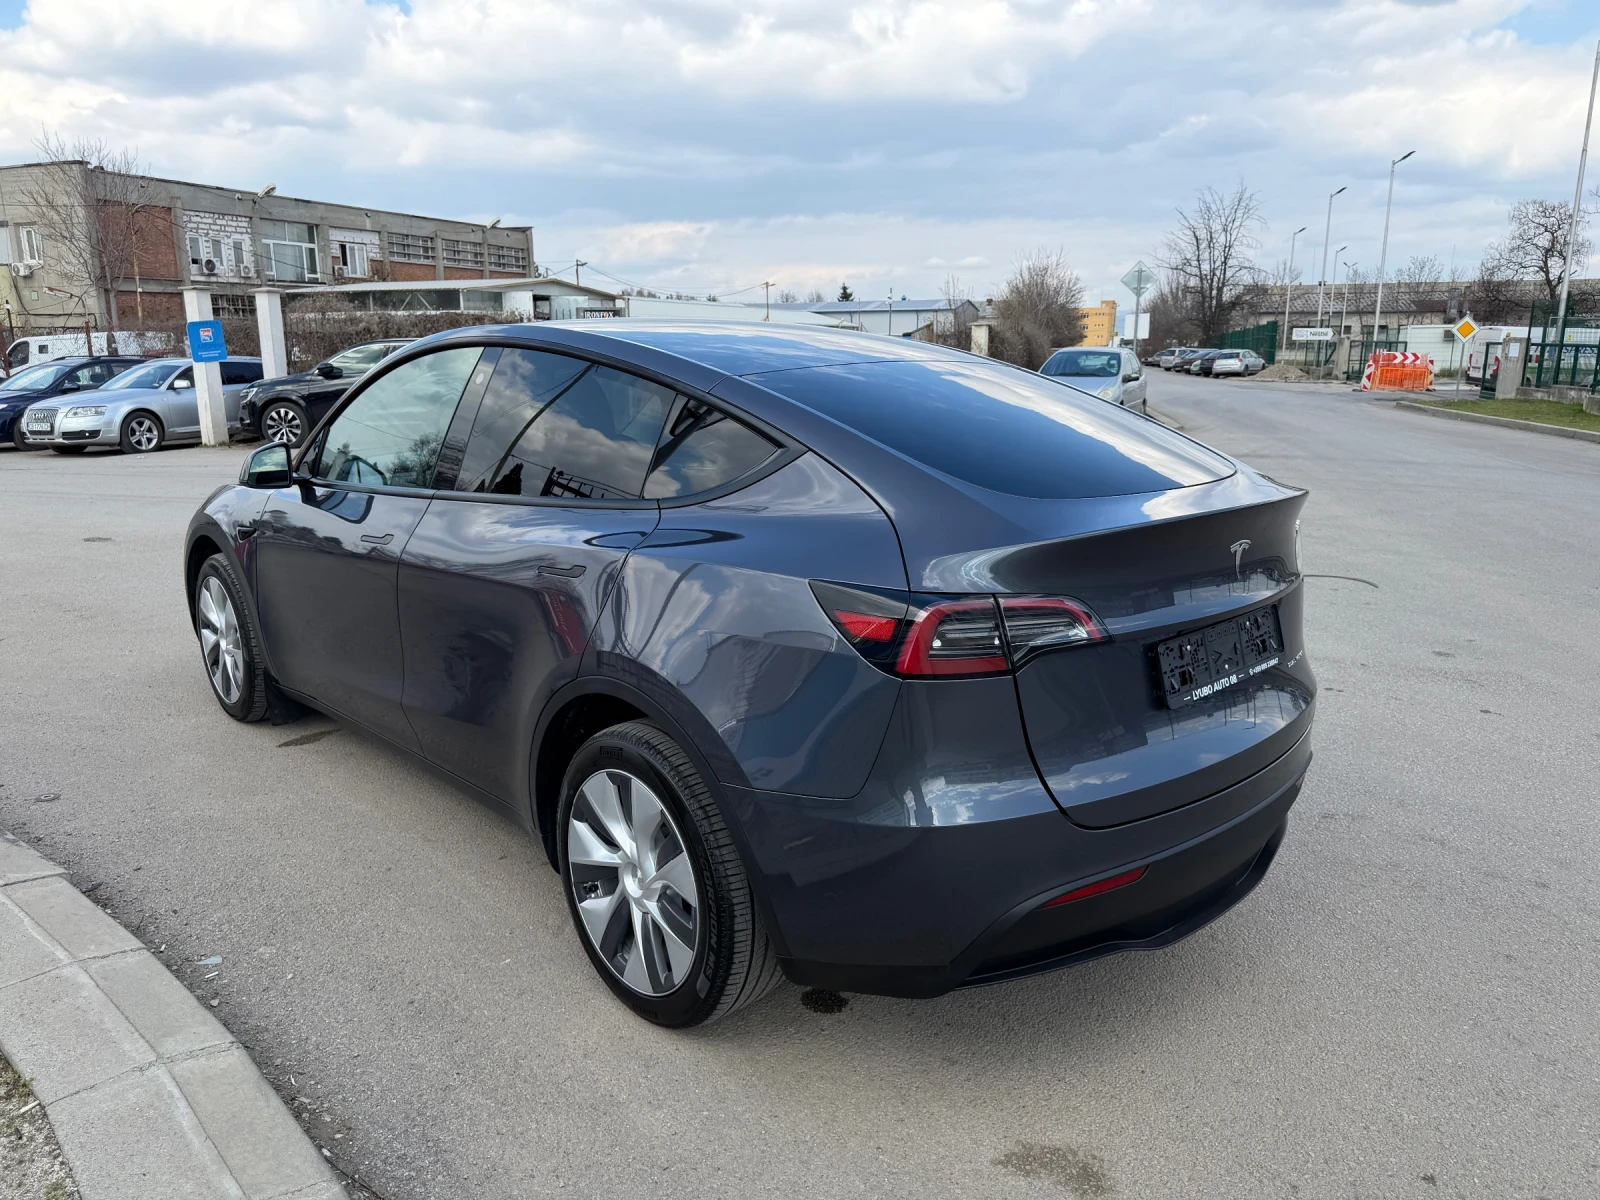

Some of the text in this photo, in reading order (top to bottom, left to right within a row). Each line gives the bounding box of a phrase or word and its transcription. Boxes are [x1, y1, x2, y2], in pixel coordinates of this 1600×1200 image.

[1192, 684, 1213, 700] LYUBO
[1213, 678, 1229, 691] AUTO
[1229, 674, 1238, 685] 08
